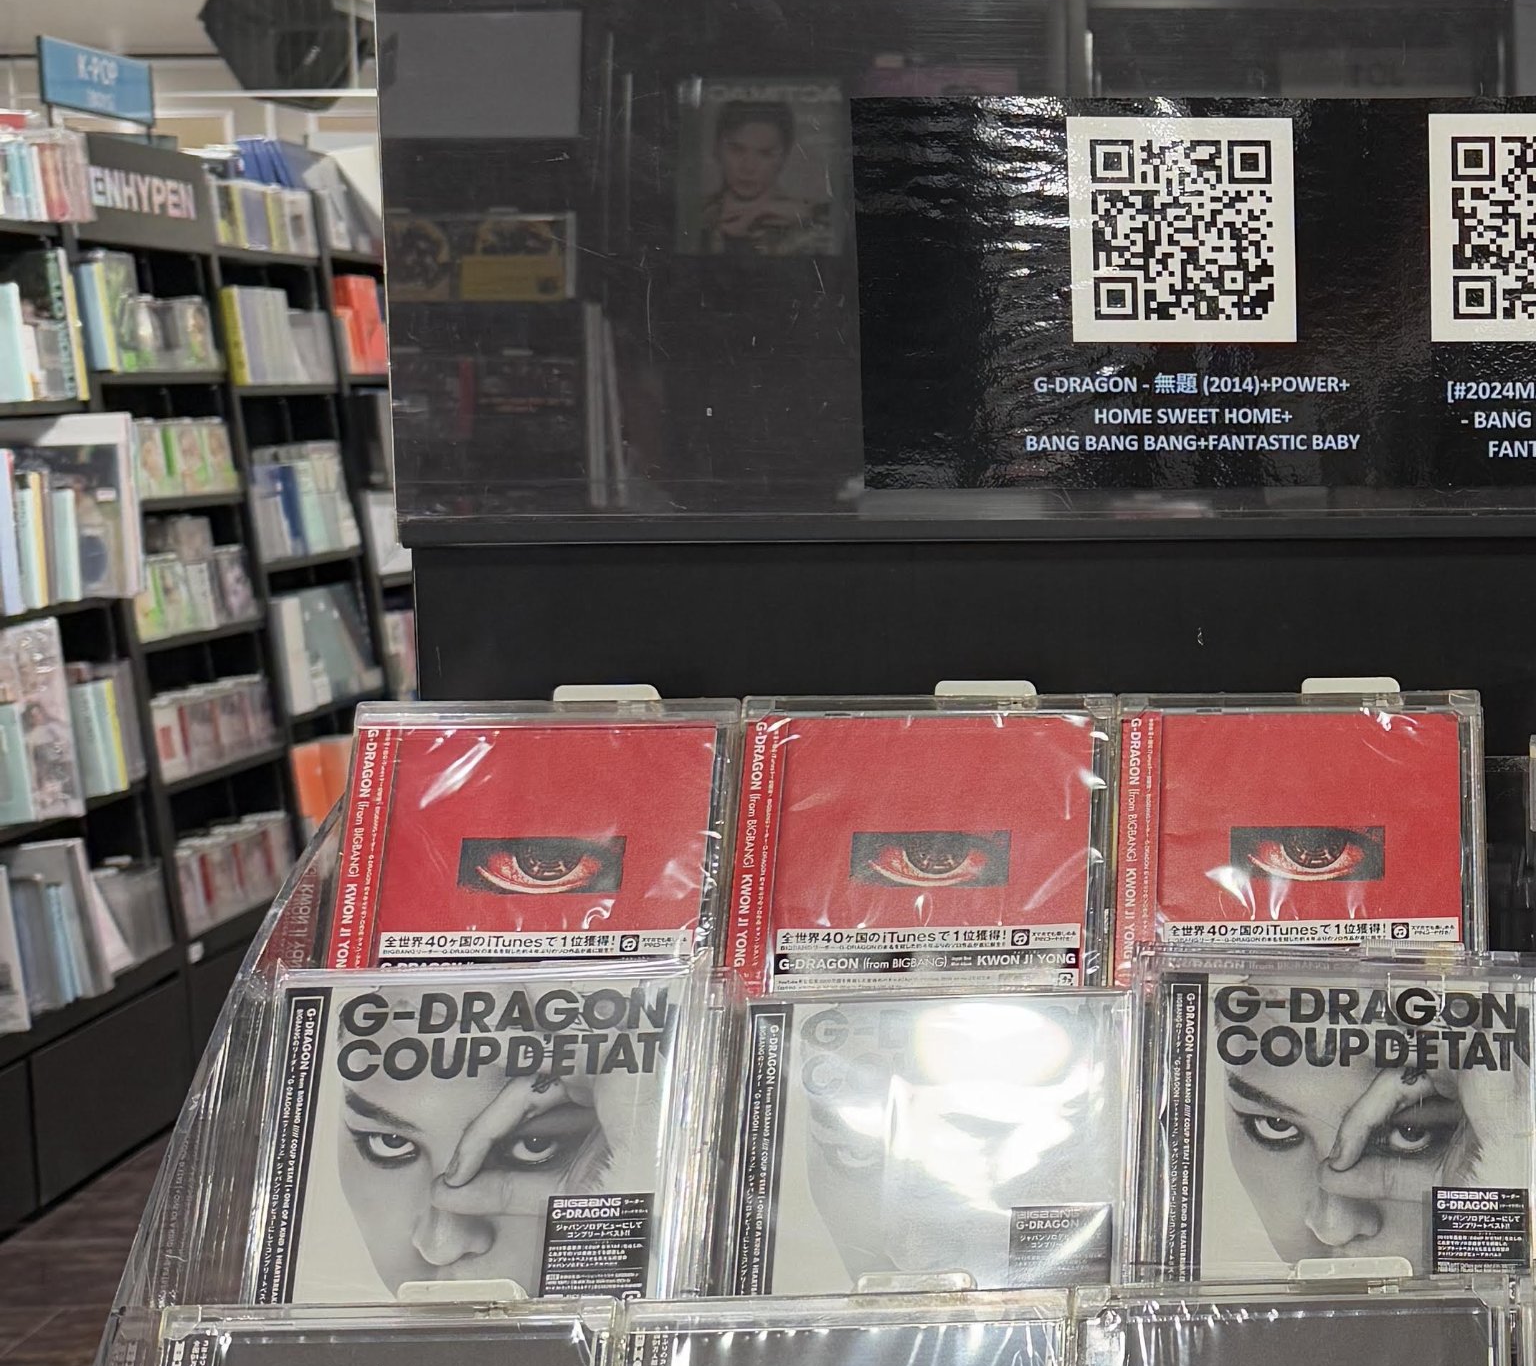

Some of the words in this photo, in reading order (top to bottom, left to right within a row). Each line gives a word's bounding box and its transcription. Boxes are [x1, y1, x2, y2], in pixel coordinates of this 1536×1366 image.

[88, 165, 197, 221] ENHYPEN
[1033, 374, 1138, 393] G-DRAGON
[1154, 372, 1199, 395] 無題
[1202, 375, 1351, 396] (2014)+POWER+
[1093, 407, 1153, 425] HOME
[1157, 407, 1219, 425] SWEET
[1223, 407, 1293, 425] HOME+
[1474, 411, 1527, 429] BANG
[1025, 435, 1080, 453] BANG
[1085, 435, 1139, 452] BANG
[1143, 434, 1307, 452] BANG+FANTASTIC
[1311, 433, 1361, 451] BABY
[359, 728, 379, 798] G-DRAGON
[750, 722, 768, 790] G-DRAGON
[1128, 717, 1142, 786] G-DRAGON
[738, 874, 753, 914] KWON
[733, 930, 748, 968] YONG
[778, 958, 859, 971] G-DRAGON
[863, 957, 889, 970] (from
[892, 955, 948, 969] BIGBANG)
[977, 954, 1019, 966] KWON
[1023, 953, 1034, 965] JI
[1037, 953, 1076, 965] YONG
[342, 987, 669, 1036] G-DRAGON
[1214, 986, 1517, 1030] G-DRAGON
[337, 1034, 501, 1082] COUP
[1217, 1025, 1371, 1067] COUP
[552, 1208, 620, 1219] G-DRAGON
[1437, 1200, 1498, 1210] G-DRAGON
